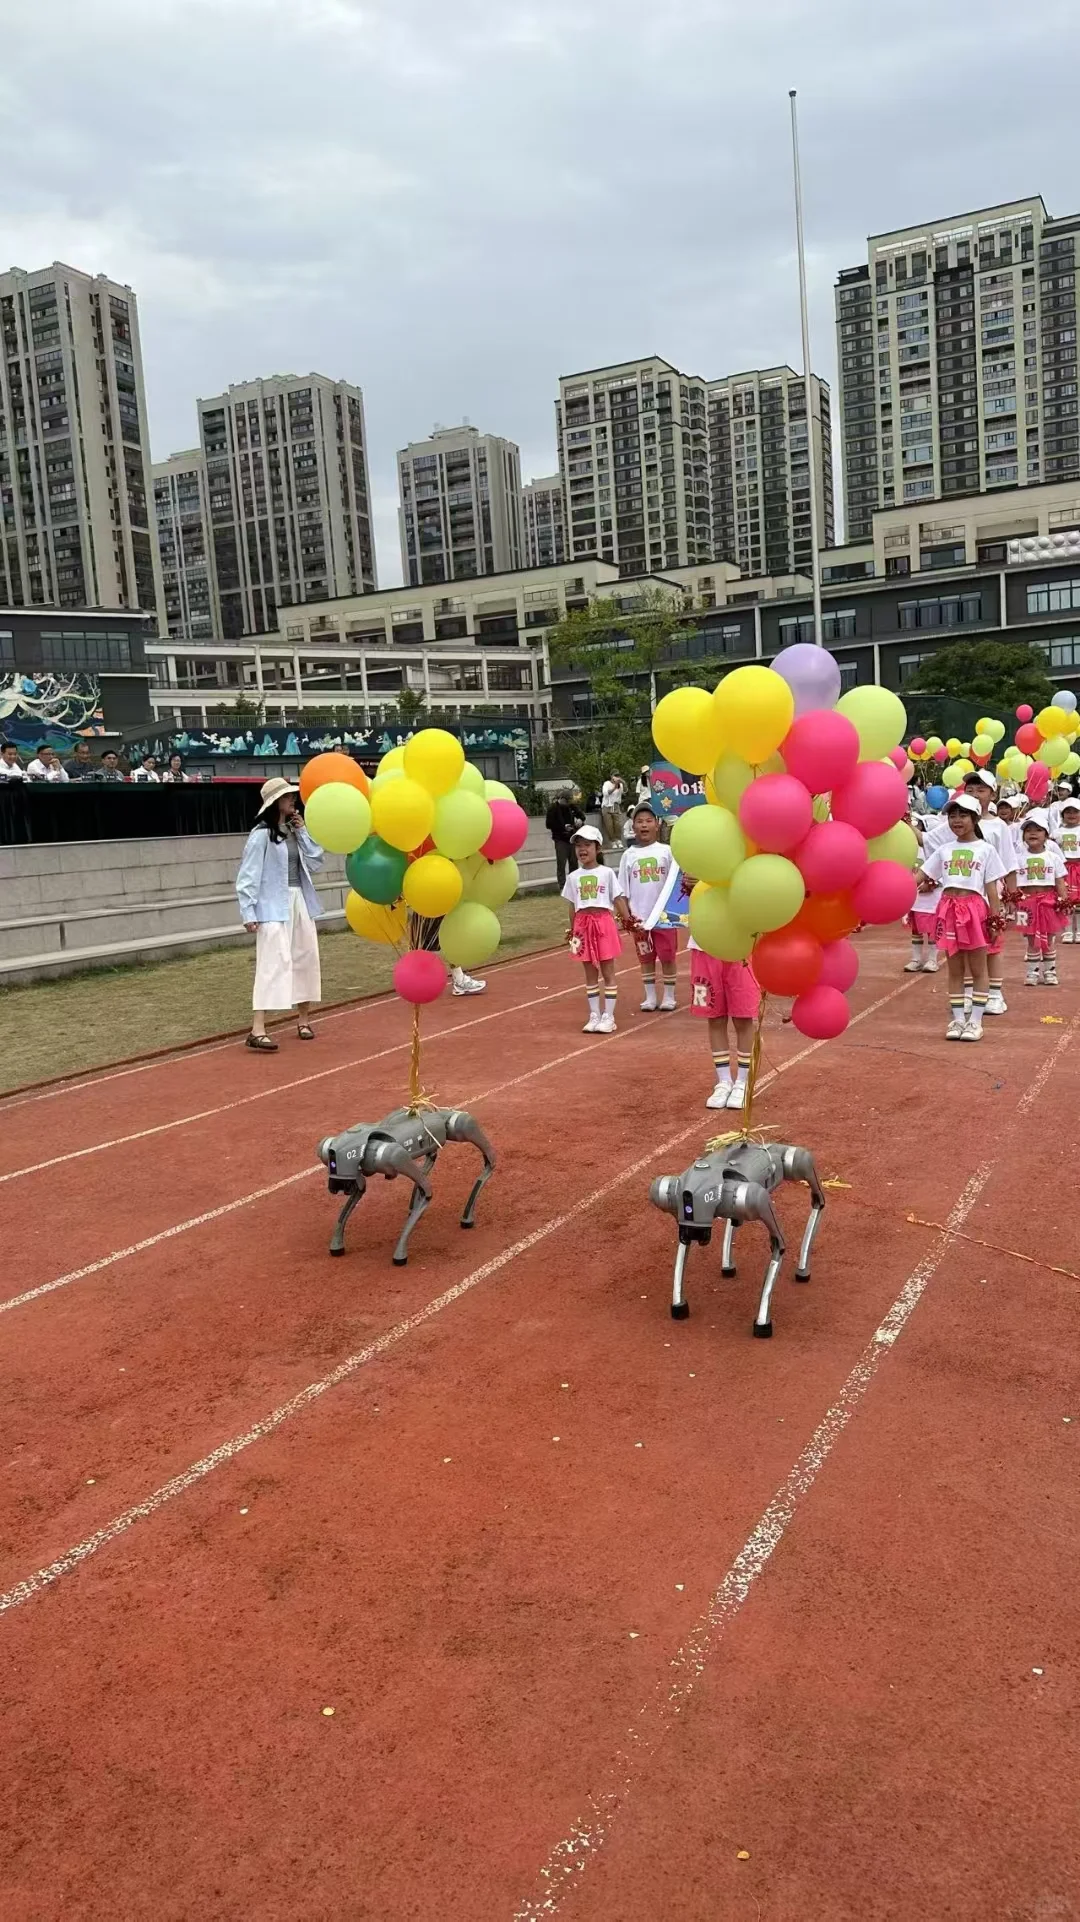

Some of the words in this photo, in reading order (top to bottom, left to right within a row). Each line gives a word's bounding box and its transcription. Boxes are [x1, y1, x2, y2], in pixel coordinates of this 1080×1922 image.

[637, 856, 660, 884] R
[944, 860, 981, 871] STRIVE
[949, 849, 974, 877] R
[1020, 866, 1053, 875] STRIVE
[1026, 857, 1045, 880] R
[633, 866, 665, 879] STRIVE
[580, 874, 598, 900] R
[1016, 911, 1029, 927] R
[636, 940, 651, 956] R
[692, 984, 708, 1007] R
[346, 1149, 357, 1160] 02
[704, 1191, 715, 1203] 02
